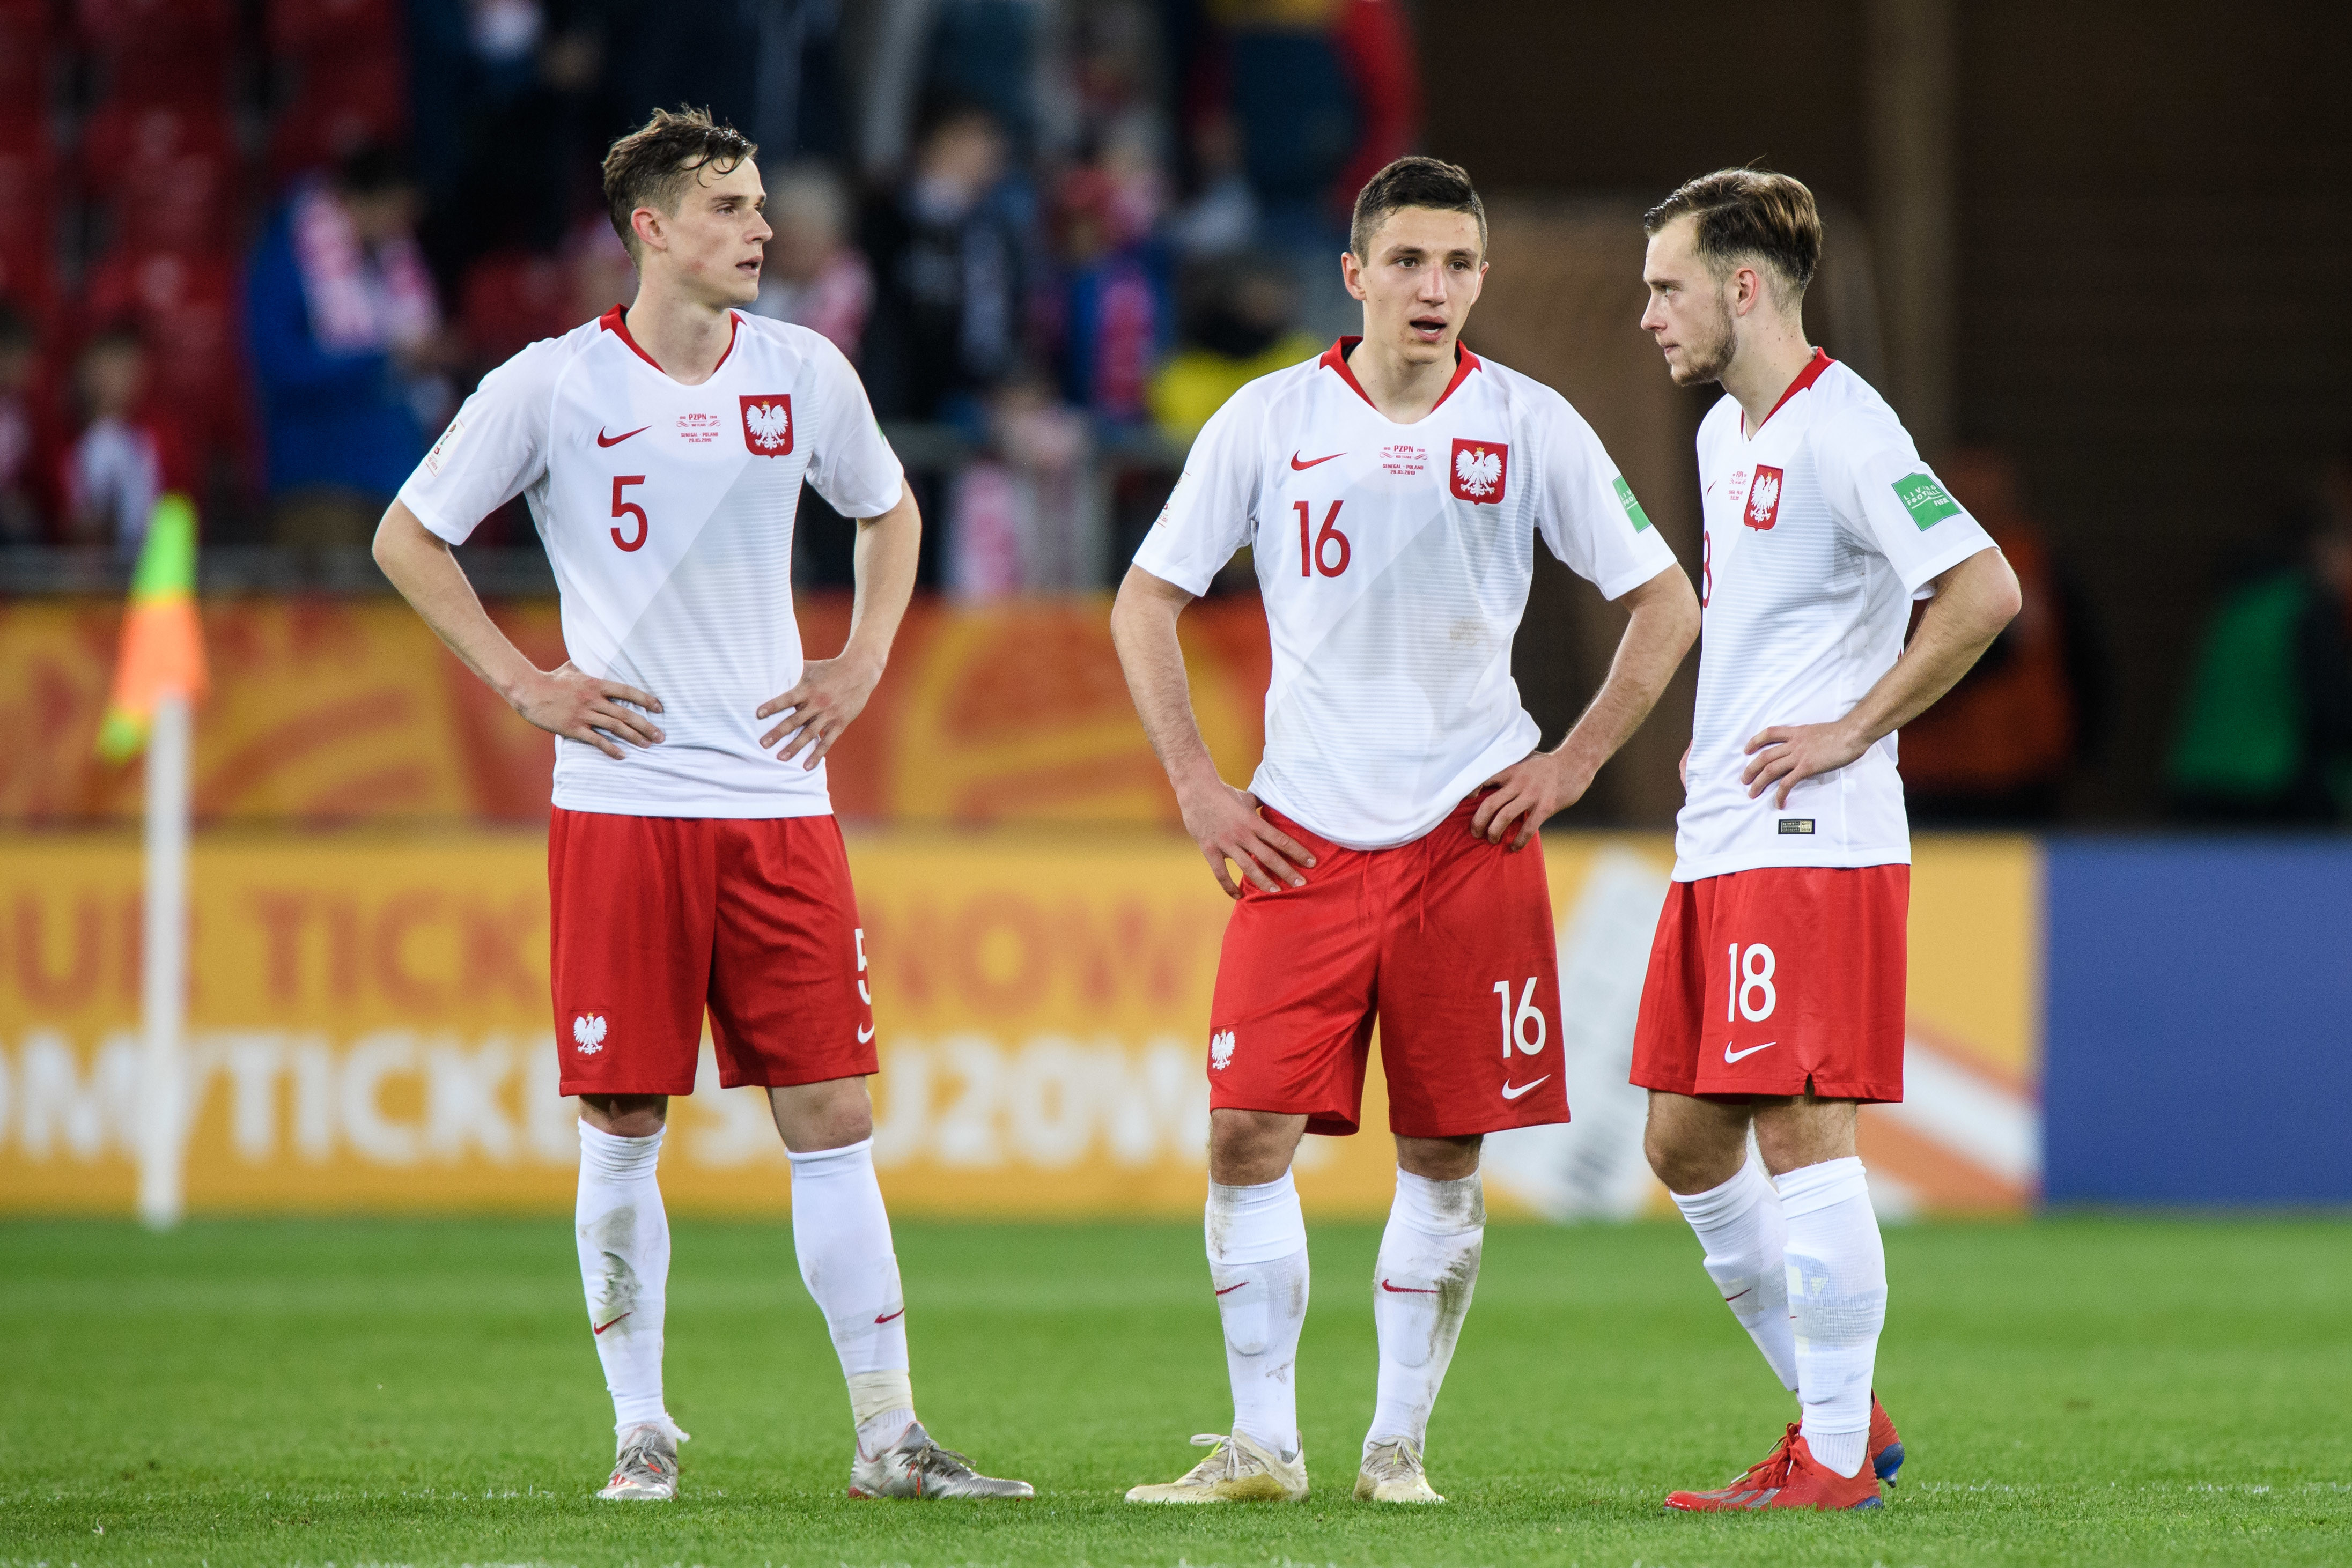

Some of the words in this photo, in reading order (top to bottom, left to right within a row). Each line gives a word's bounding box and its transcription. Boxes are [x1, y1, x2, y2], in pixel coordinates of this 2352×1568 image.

[610, 475, 648, 552] 5
[1903, 485, 1936, 501] LIVING
[1933, 497, 1950, 506] FIFA
[1293, 500, 1351, 578] 16
[239, 885, 558, 1015] TICK
[1728, 943, 1777, 1022] 18
[1493, 977, 1547, 1059] 16
